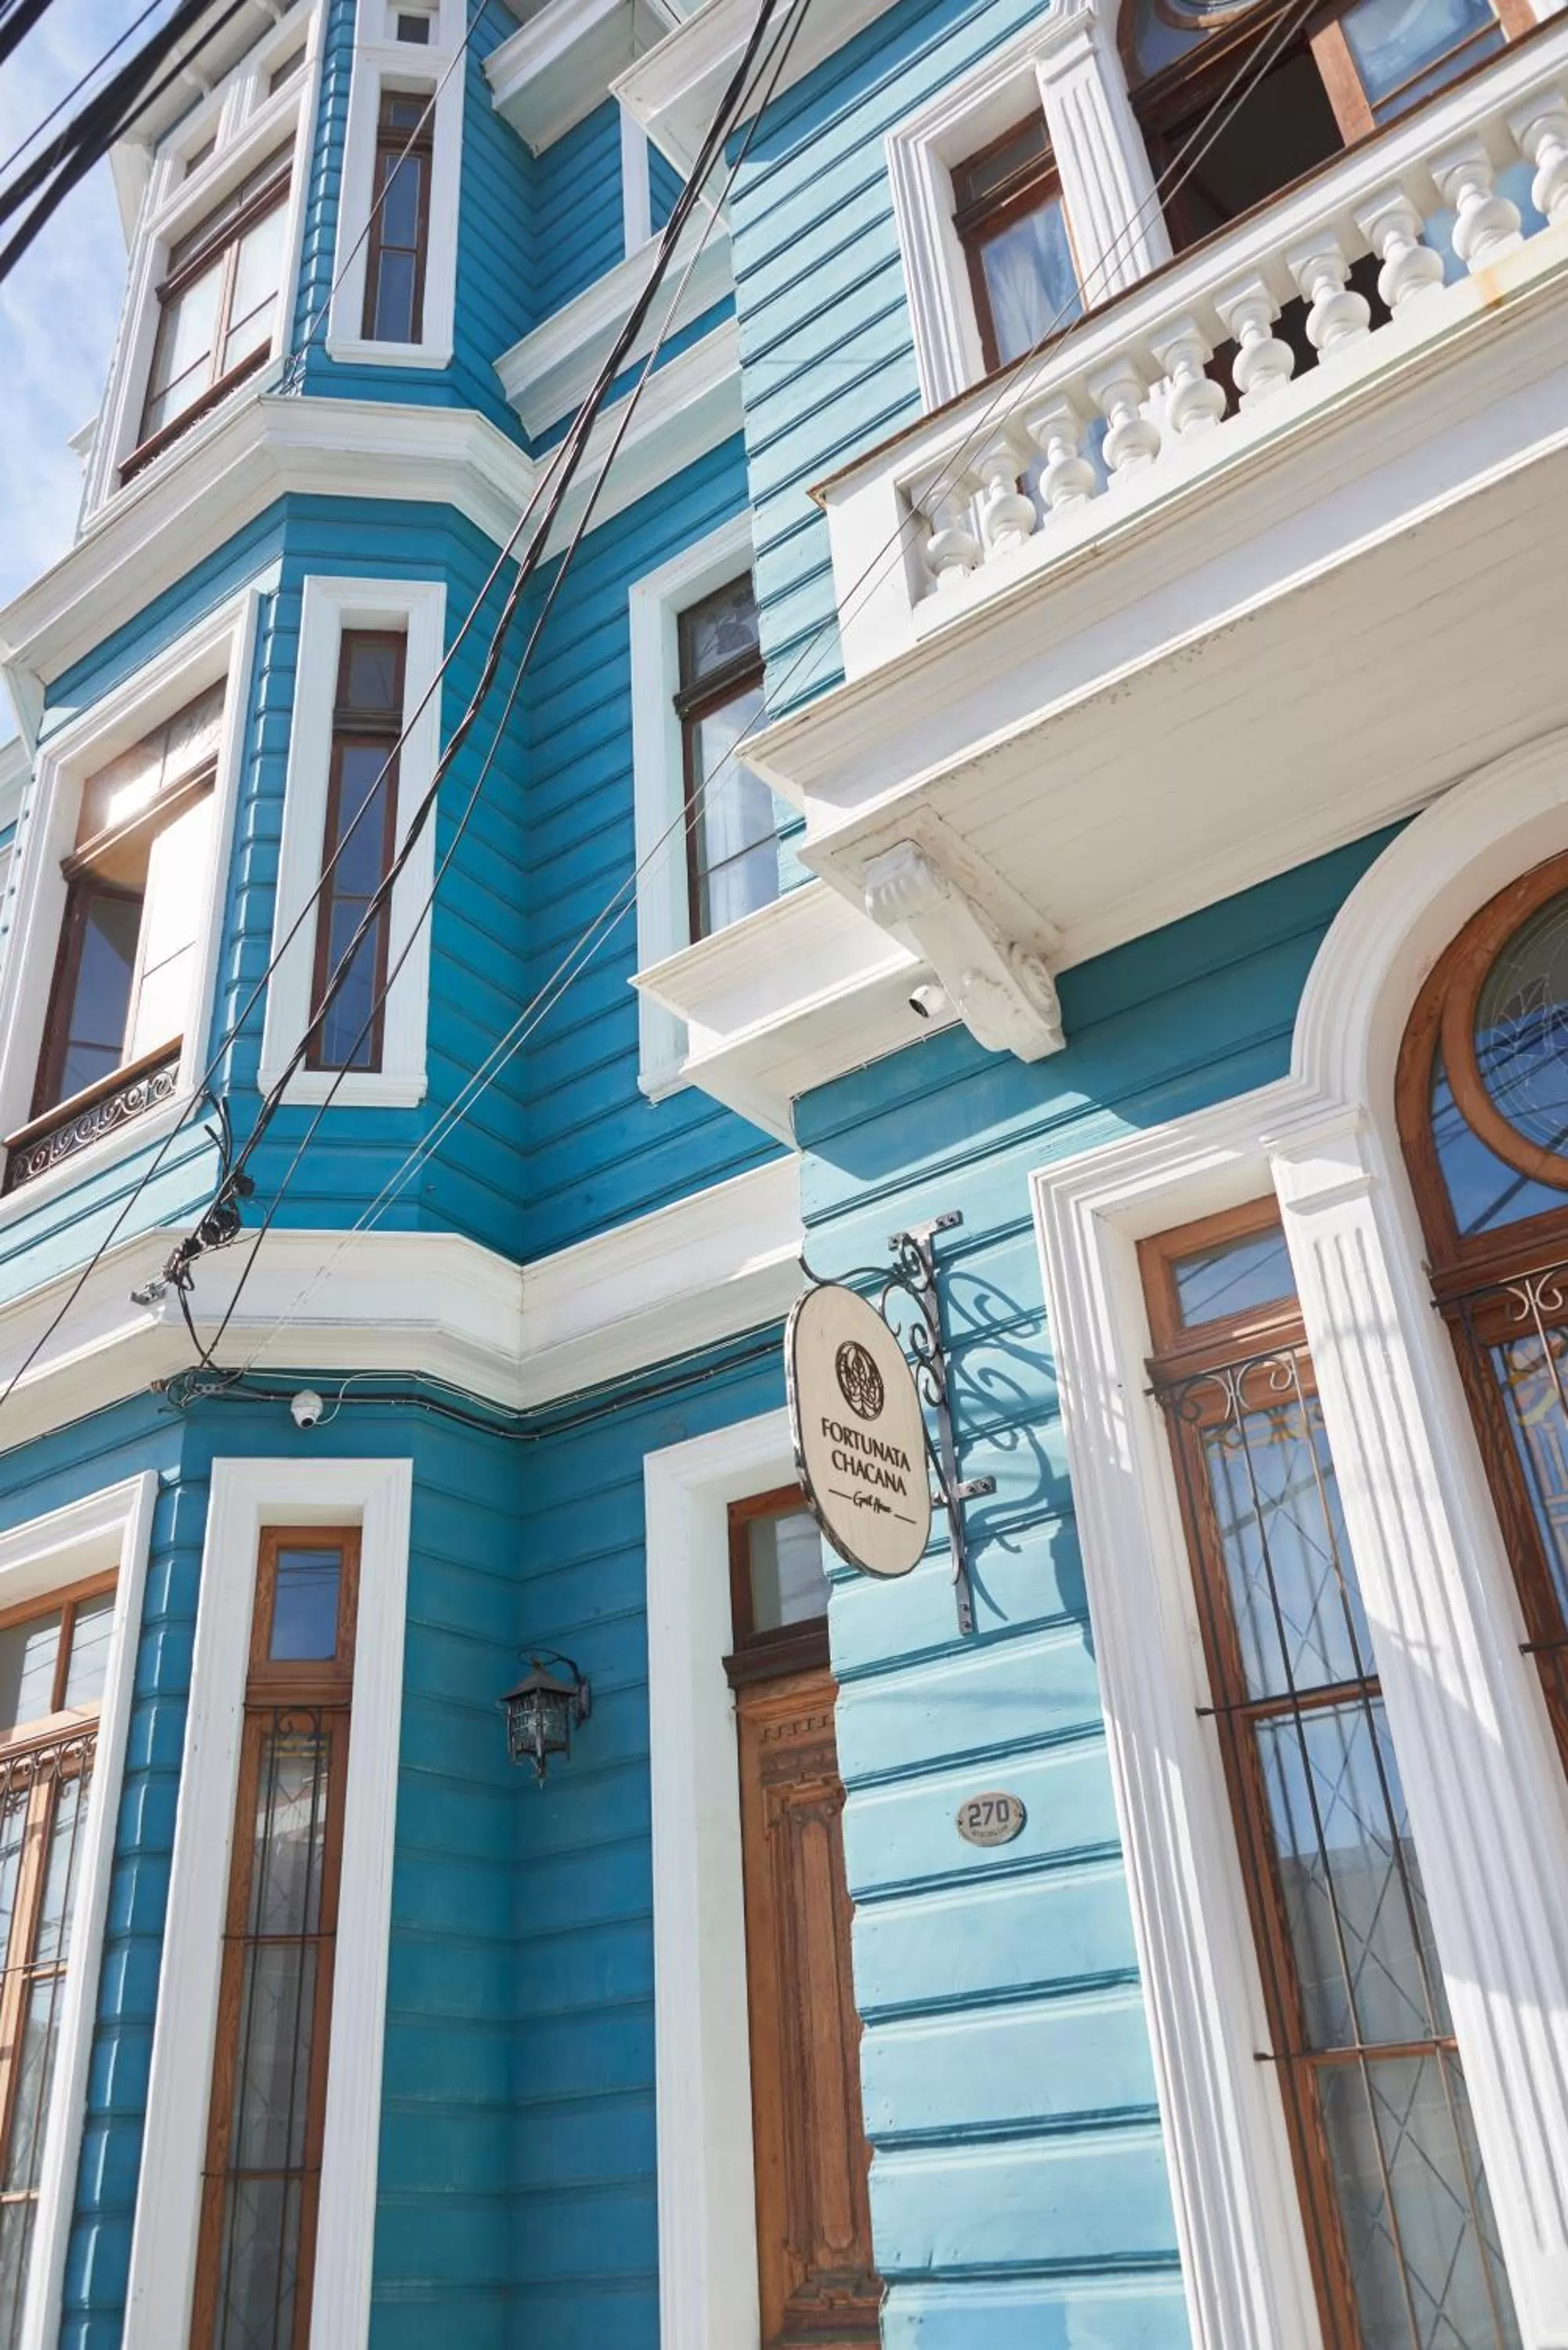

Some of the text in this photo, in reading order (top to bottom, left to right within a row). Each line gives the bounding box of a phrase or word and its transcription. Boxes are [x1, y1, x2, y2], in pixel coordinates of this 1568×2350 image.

[822, 1417, 911, 1472] FORTUNATA
[832, 1450, 907, 1495] CHACANA
[967, 1799, 1009, 1828] 270
